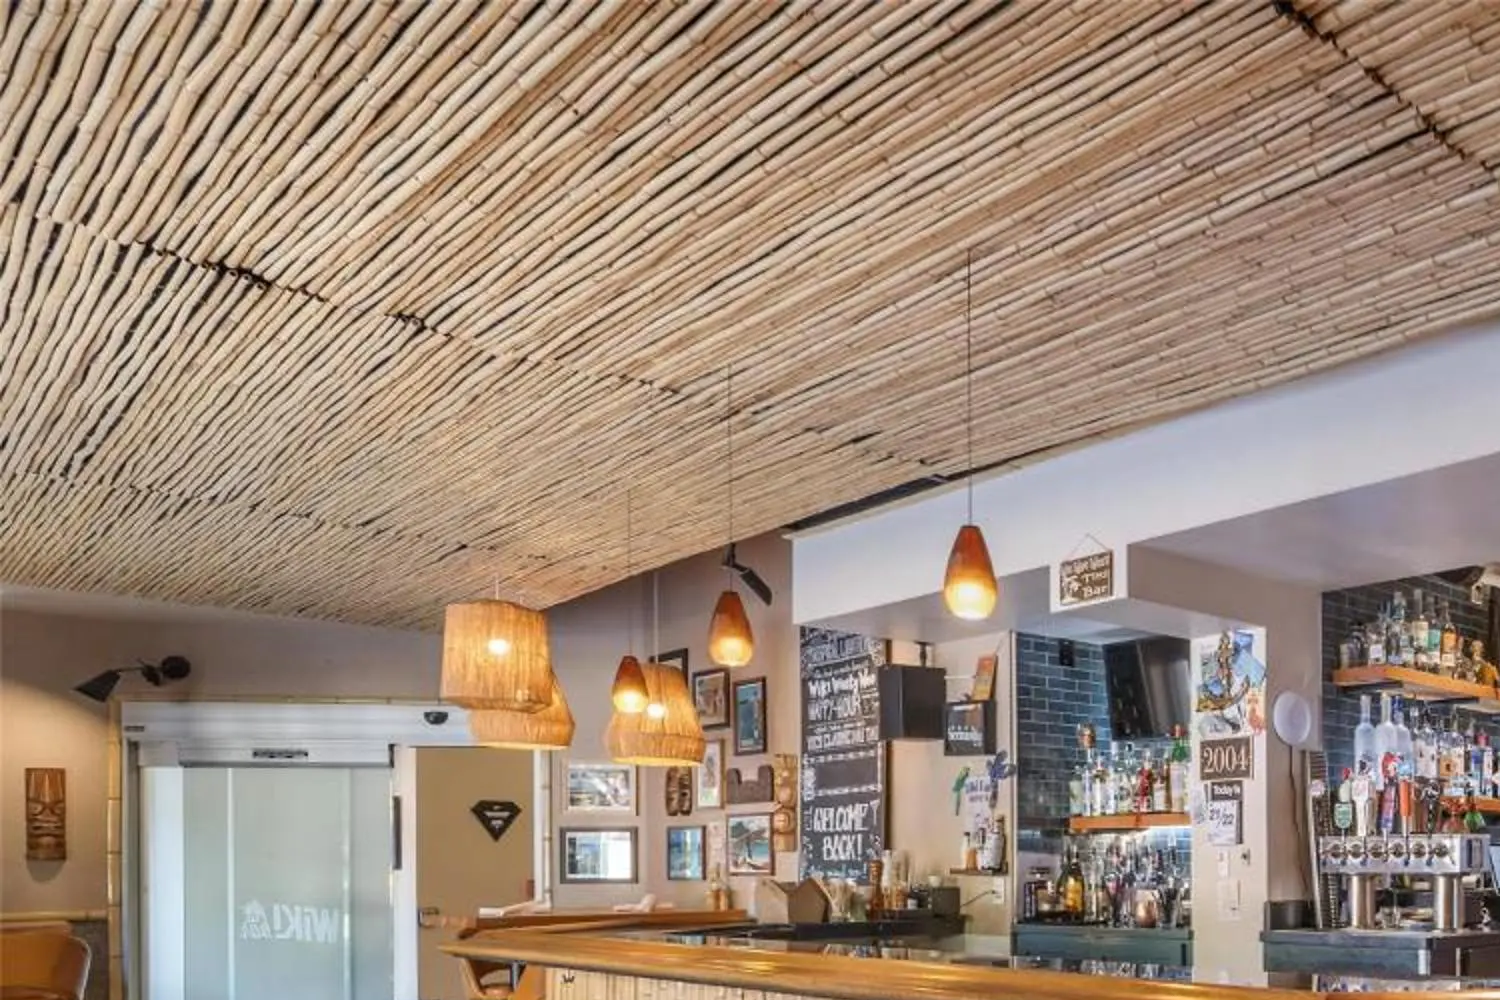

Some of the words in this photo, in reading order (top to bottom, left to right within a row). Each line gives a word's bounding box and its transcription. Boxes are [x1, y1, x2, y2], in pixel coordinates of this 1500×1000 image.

[1203, 745, 1248, 772] 2004
[813, 802, 870, 833] WELCOME
[823, 834, 862, 862] BACK!
